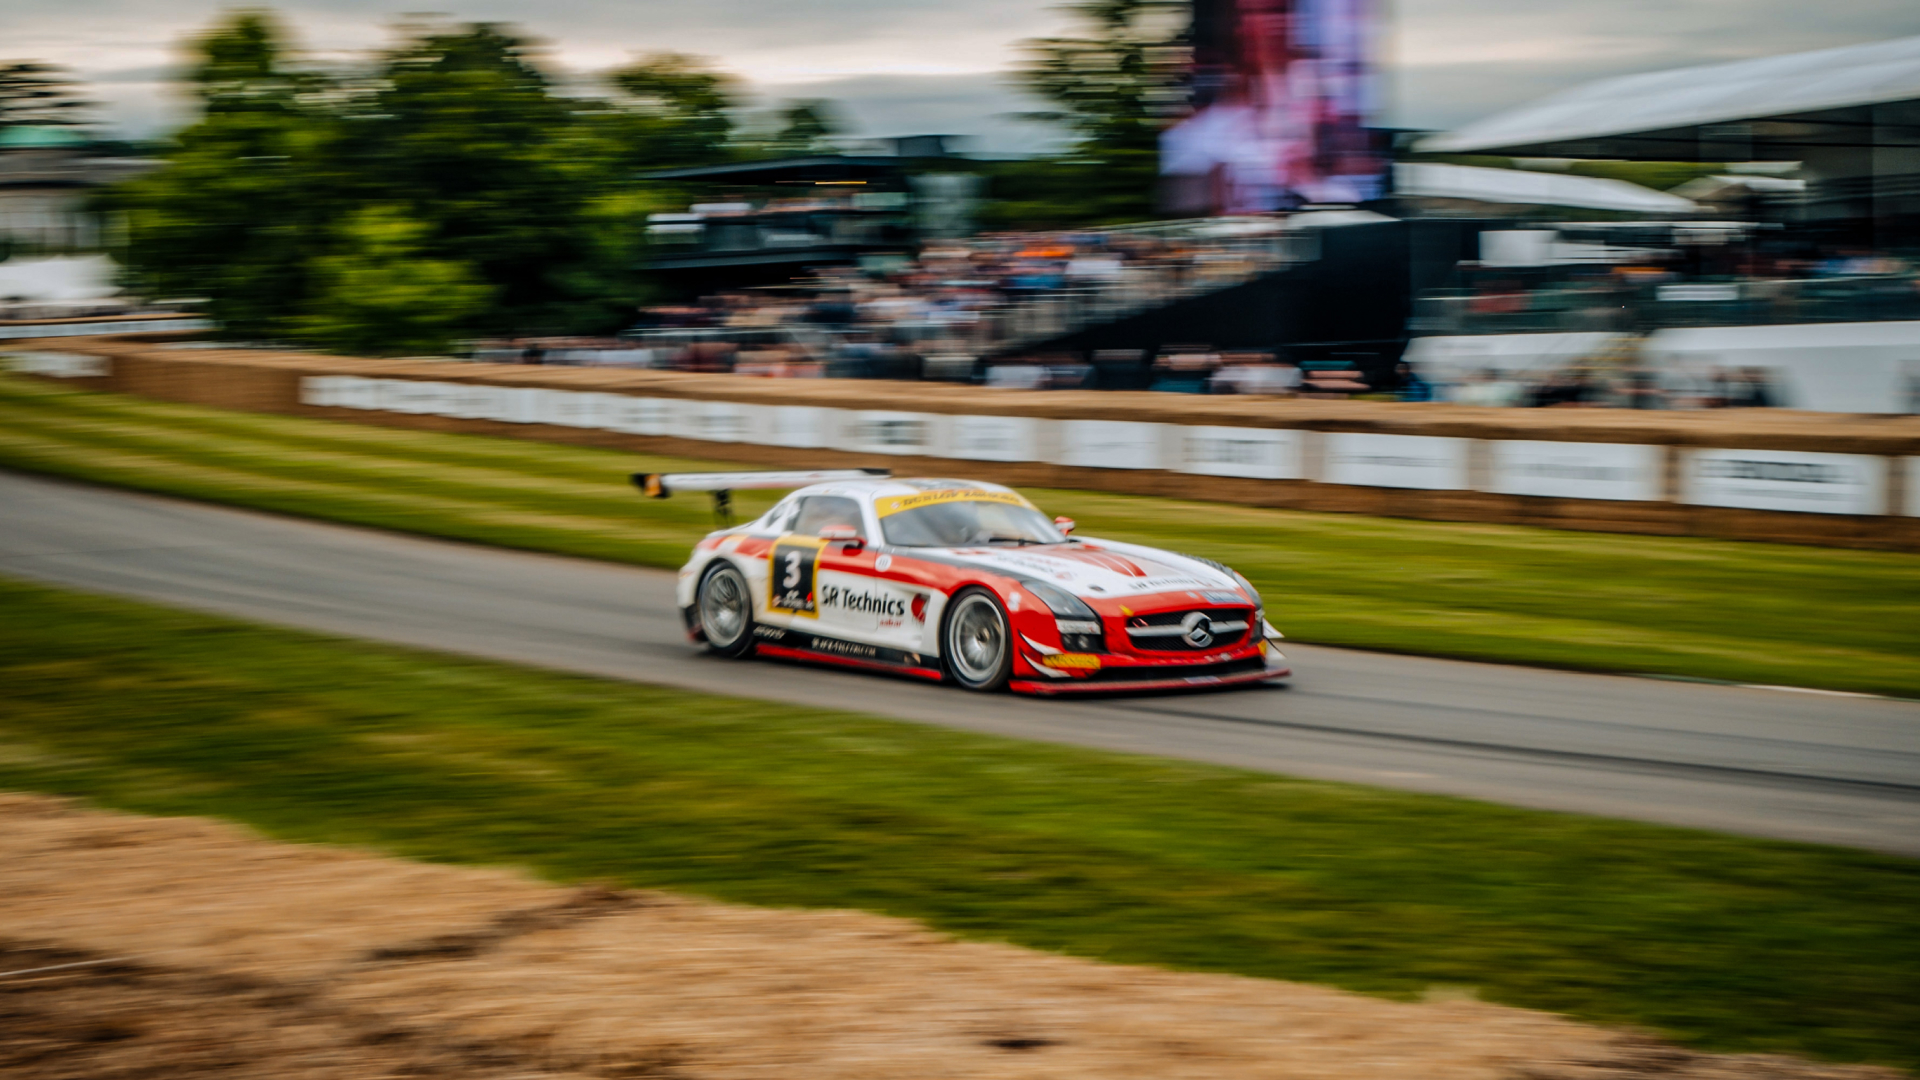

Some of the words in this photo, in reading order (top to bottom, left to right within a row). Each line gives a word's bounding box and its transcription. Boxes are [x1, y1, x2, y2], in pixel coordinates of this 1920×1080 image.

[784, 550, 801, 588] 3
[822, 584, 839, 608] SR
[841, 587, 905, 616] Technics
